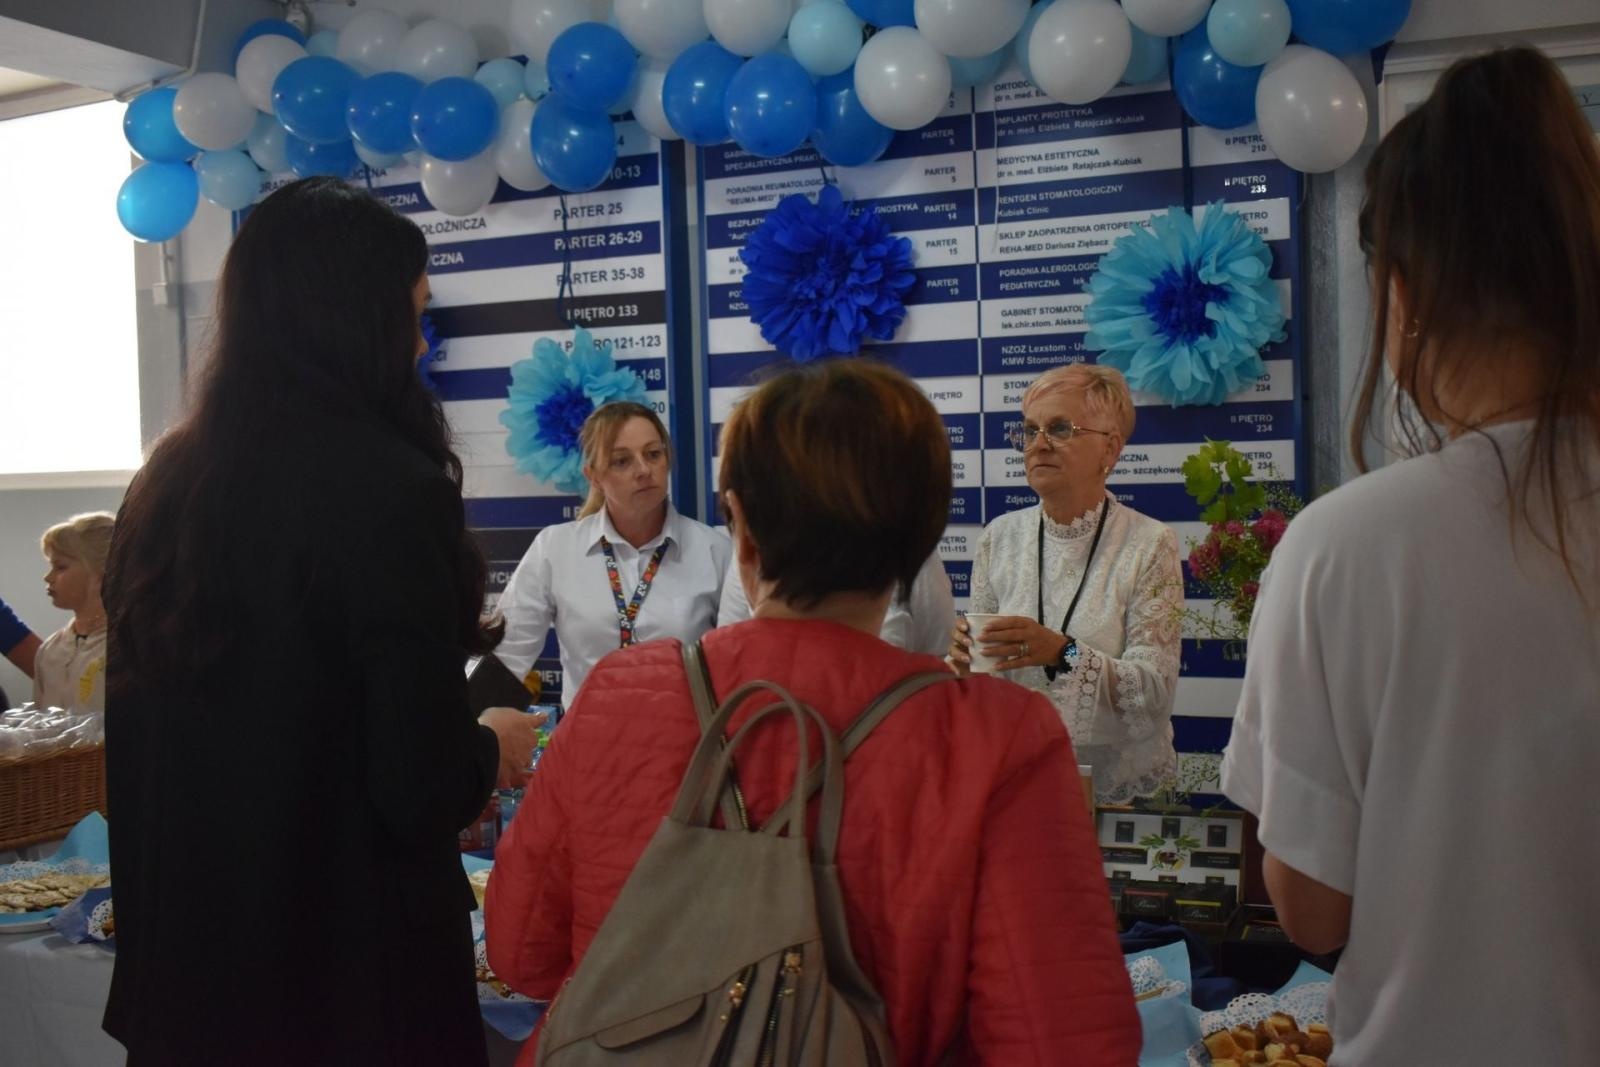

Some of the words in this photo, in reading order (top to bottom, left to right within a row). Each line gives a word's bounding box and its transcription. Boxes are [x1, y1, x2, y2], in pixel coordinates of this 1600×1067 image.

[1041, 107, 1094, 119] PROTETYKA
[921, 128, 955, 140] PARTER
[1251, 144, 1267, 153] 210
[996, 151, 1043, 165] MEDYCYNA
[1045, 148, 1100, 161] ESTETYCZNA
[724, 156, 793, 171] SPECJALISTYCZNA
[1016, 166, 1034, 175] med.
[1073, 156, 1143, 171] Ratajczak-Kubiak
[924, 166, 956, 176] PARTER
[1232, 175, 1267, 186] PIĘTRO
[726, 184, 763, 195] PORADNIA
[998, 193, 1038, 205] RENTGEN
[1039, 184, 1124, 200] STOMATOLOGICZNY
[1250, 185, 1267, 194] 235
[554, 204, 605, 220] PARTER
[608, 202, 623, 215] 25
[924, 203, 957, 213] PARTER
[998, 206, 1024, 218] Kubiak
[1026, 206, 1049, 215] Clinic
[947, 212, 957, 221] 14
[419, 217, 487, 236] OŁOŻNICZA
[999, 229, 1026, 240] SKLEP
[1028, 224, 1091, 238] ZAOPATRZENIA
[554, 234, 606, 251] PARTER
[608, 230, 643, 245] 26-29
[926, 238, 957, 248] PARTER
[999, 243, 1043, 254] REHA-MED
[1045, 239, 1075, 249] Dariusz
[1077, 237, 1109, 250] Ziębacz
[948, 248, 958, 256] 15
[556, 270, 608, 286] PRTER
[611, 267, 645, 281] 35-38
[999, 267, 1039, 277] PORADNIA
[926, 278, 958, 288] PARTER
[999, 279, 1060, 291] PEDIATRYCZNA
[949, 287, 959, 296] 19
[573, 305, 615, 322] PIĘTRO
[618, 304, 639, 317] 133
[1001, 307, 1038, 318] GABINET
[614, 335, 662, 349] 121-123
[1001, 344, 1027, 355] NZOZ
[1028, 343, 1067, 354] Lexstom
[1001, 356, 1025, 367] KMW
[1026, 354, 1086, 365] Stomatologia
[1255, 384, 1271, 392] 234
[933, 390, 963, 401] PIĘTRO
[1238, 413, 1274, 425] PIĘTRO
[1256, 424, 1273, 433] 234
[1005, 495, 1037, 505] Zdjęcia
